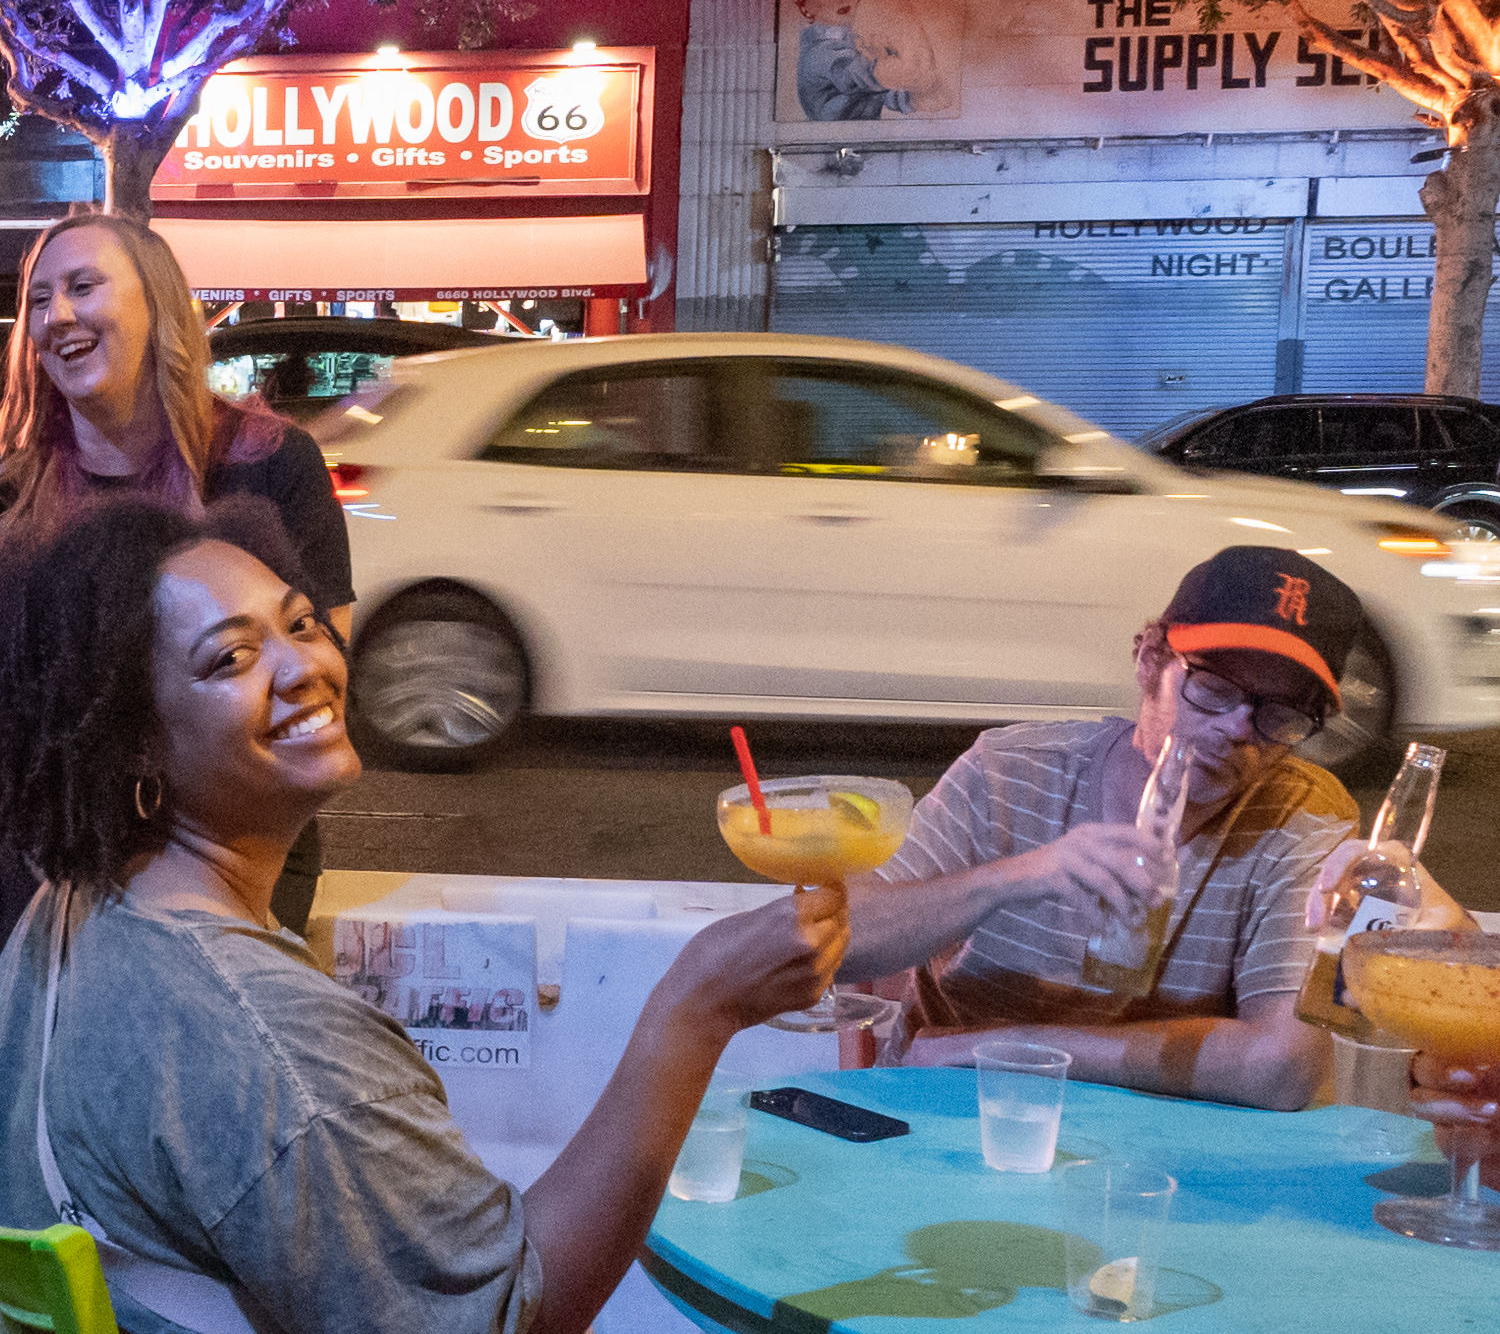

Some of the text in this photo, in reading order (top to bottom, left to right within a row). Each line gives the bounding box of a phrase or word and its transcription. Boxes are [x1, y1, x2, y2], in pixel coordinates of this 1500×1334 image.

[1082, 31, 1281, 93] SUPPLY
[174, 81, 514, 147] HOLLYWOOD
[537, 104, 588, 131] 66
[183, 142, 589, 171] Souvenirs Gifts Sports
[191, 289, 396, 302] VENIRS GIFTS SPORTS
[472, 288, 558, 301] HOLLYWOOD
[561, 287, 596, 299] Blvd.
